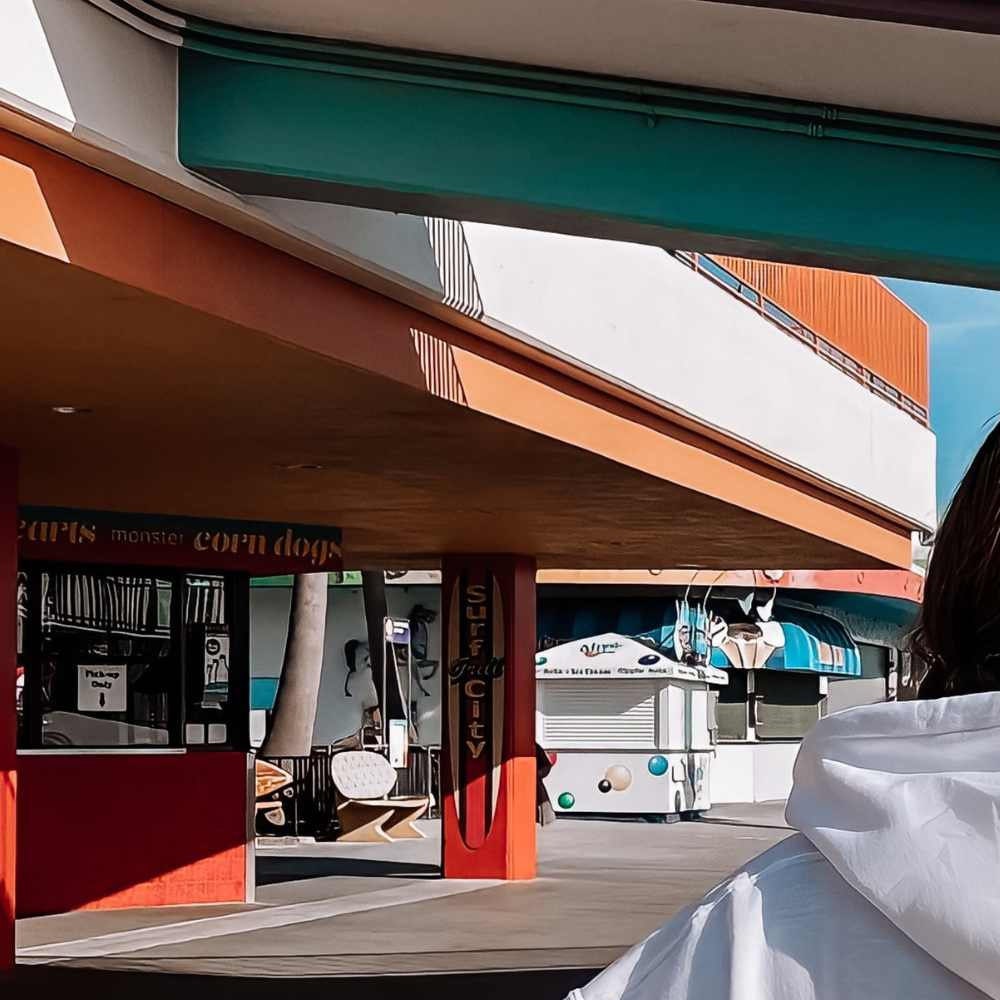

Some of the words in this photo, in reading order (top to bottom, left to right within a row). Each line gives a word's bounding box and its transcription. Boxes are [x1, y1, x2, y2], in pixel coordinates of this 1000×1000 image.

[111, 529, 184, 545] monster
[194, 531, 266, 554] corn
[273, 528, 343, 566] dogs
